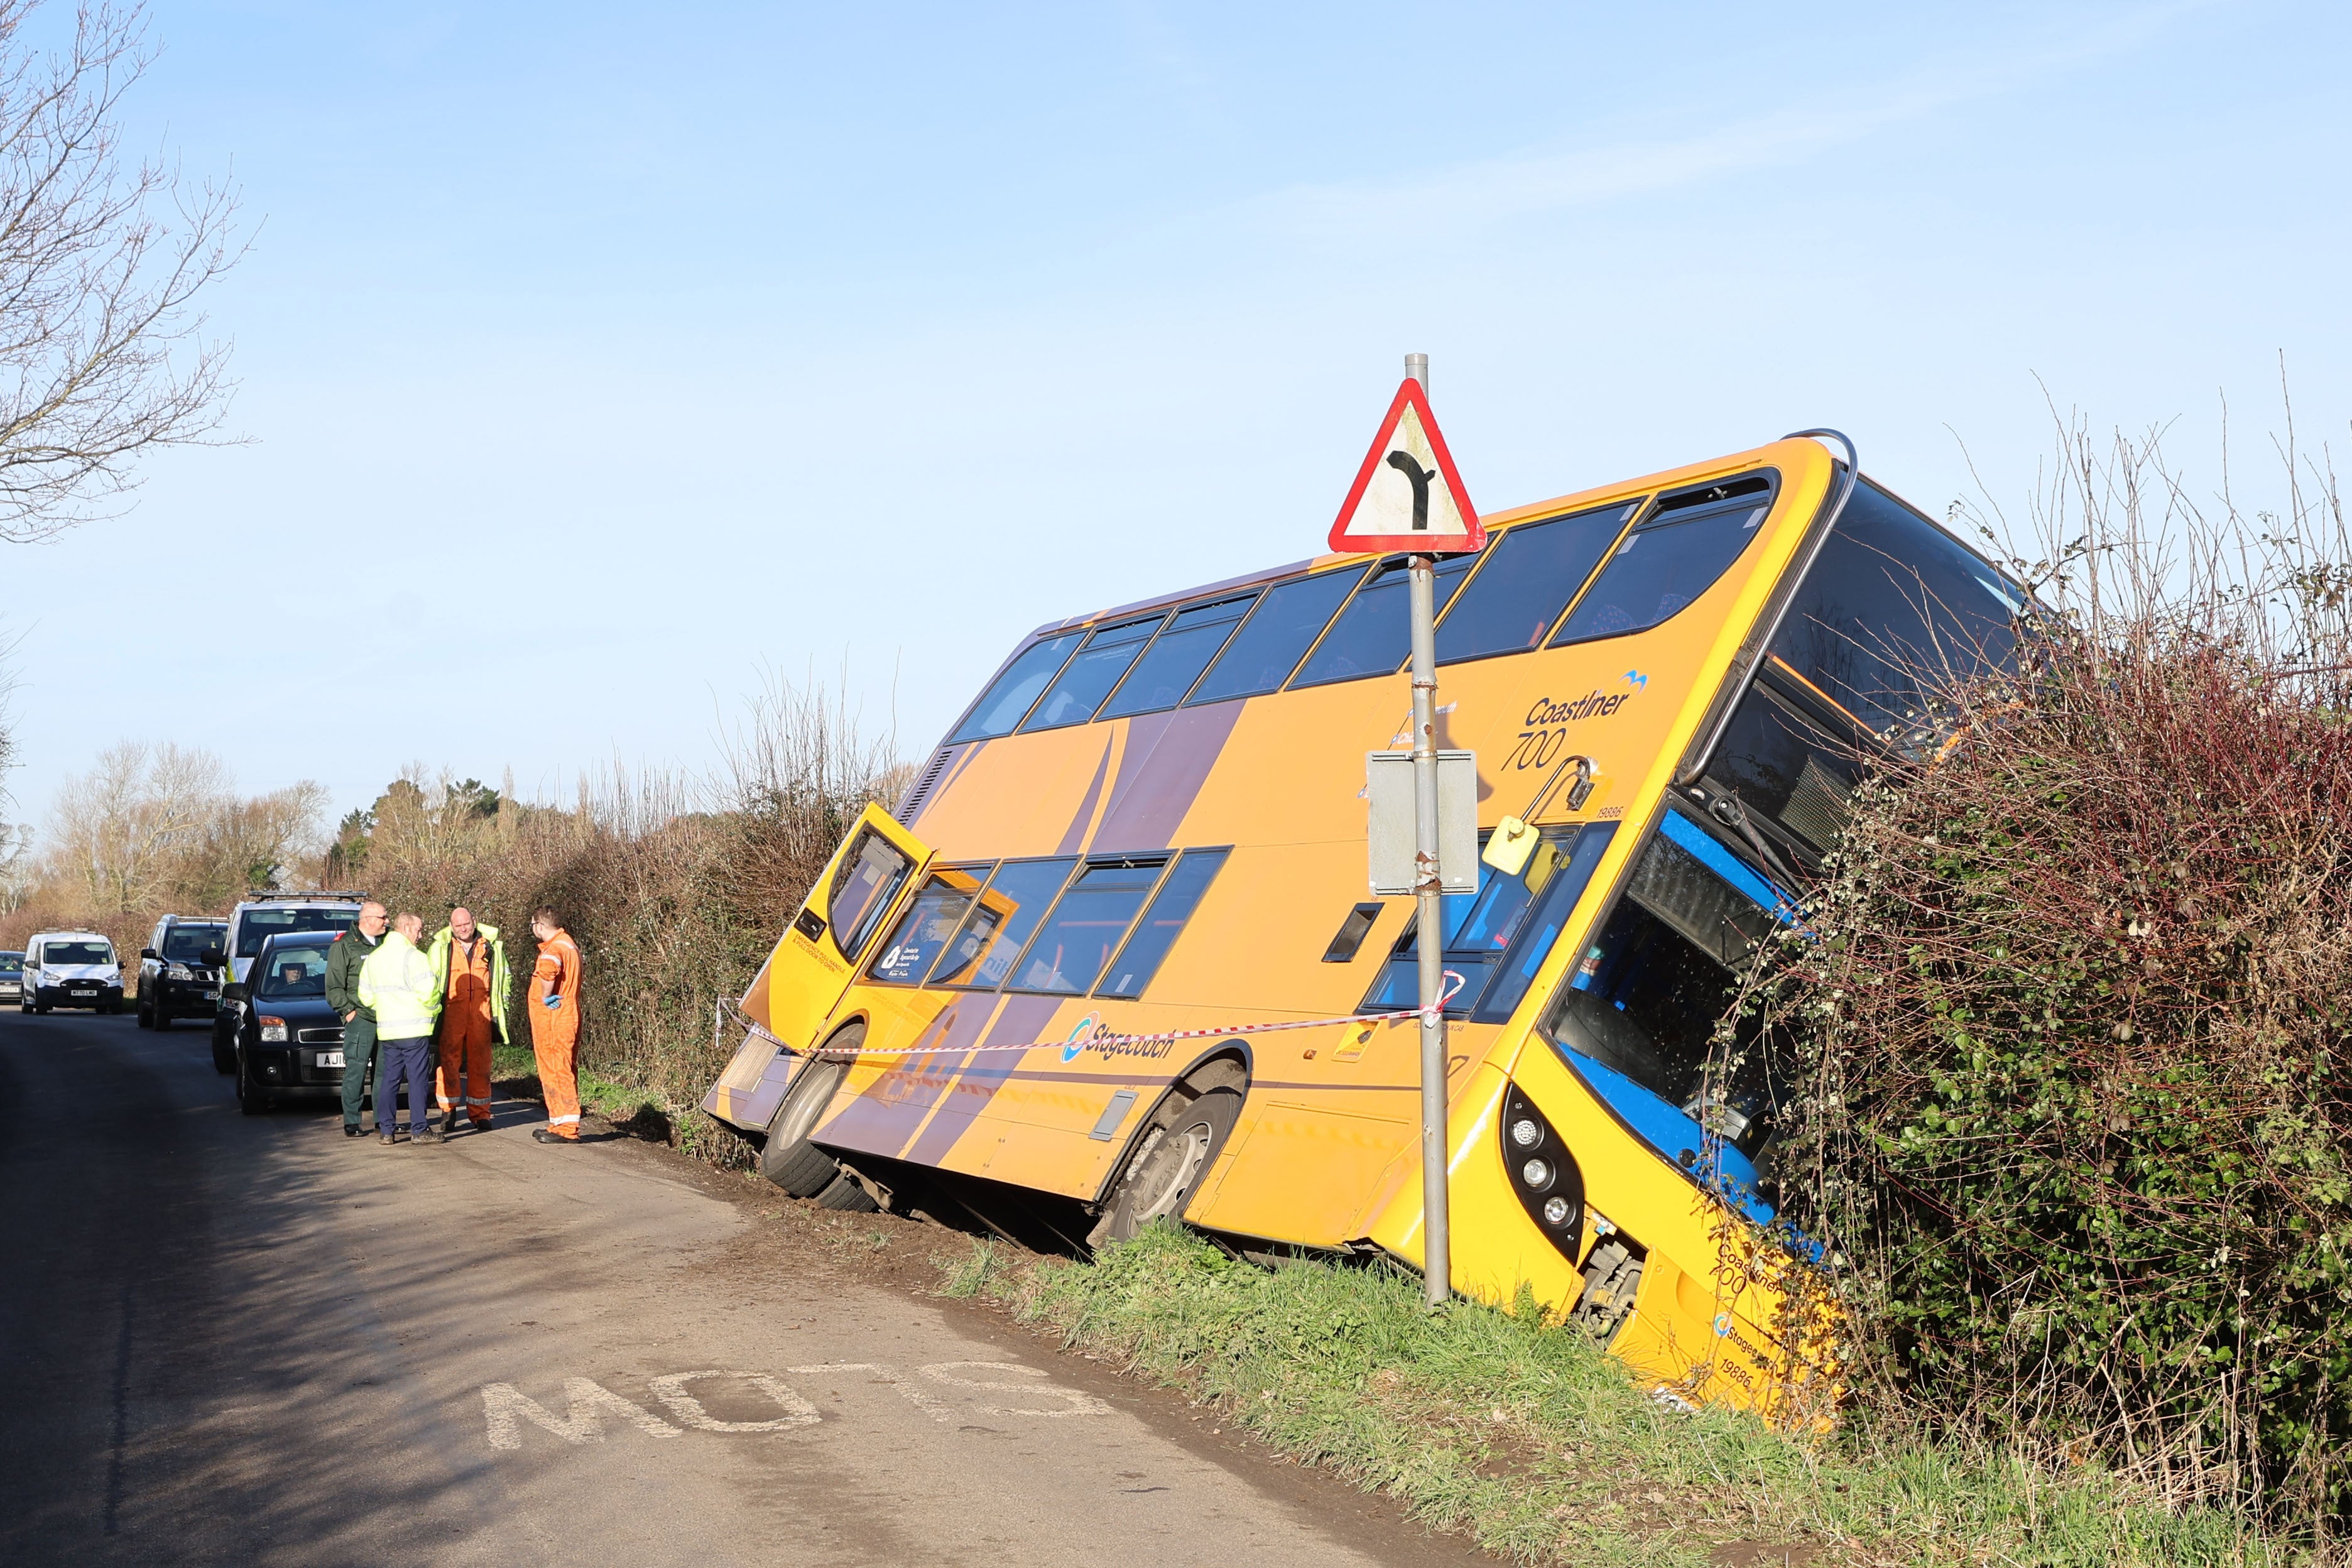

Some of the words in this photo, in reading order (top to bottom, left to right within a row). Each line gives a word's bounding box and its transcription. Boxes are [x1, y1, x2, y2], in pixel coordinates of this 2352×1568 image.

[1525, 689, 1630, 726] Coastliner
[1500, 727, 1567, 771] 700
[1596, 806, 1624, 819] 19886
[795, 934, 820, 954] EMERGENCY
[829, 958, 846, 974] HANDLE
[1086, 1023, 1177, 1060] Stagecoach
[1709, 1258, 1747, 1294] 700
[1719, 1358, 1753, 1387] 19886
